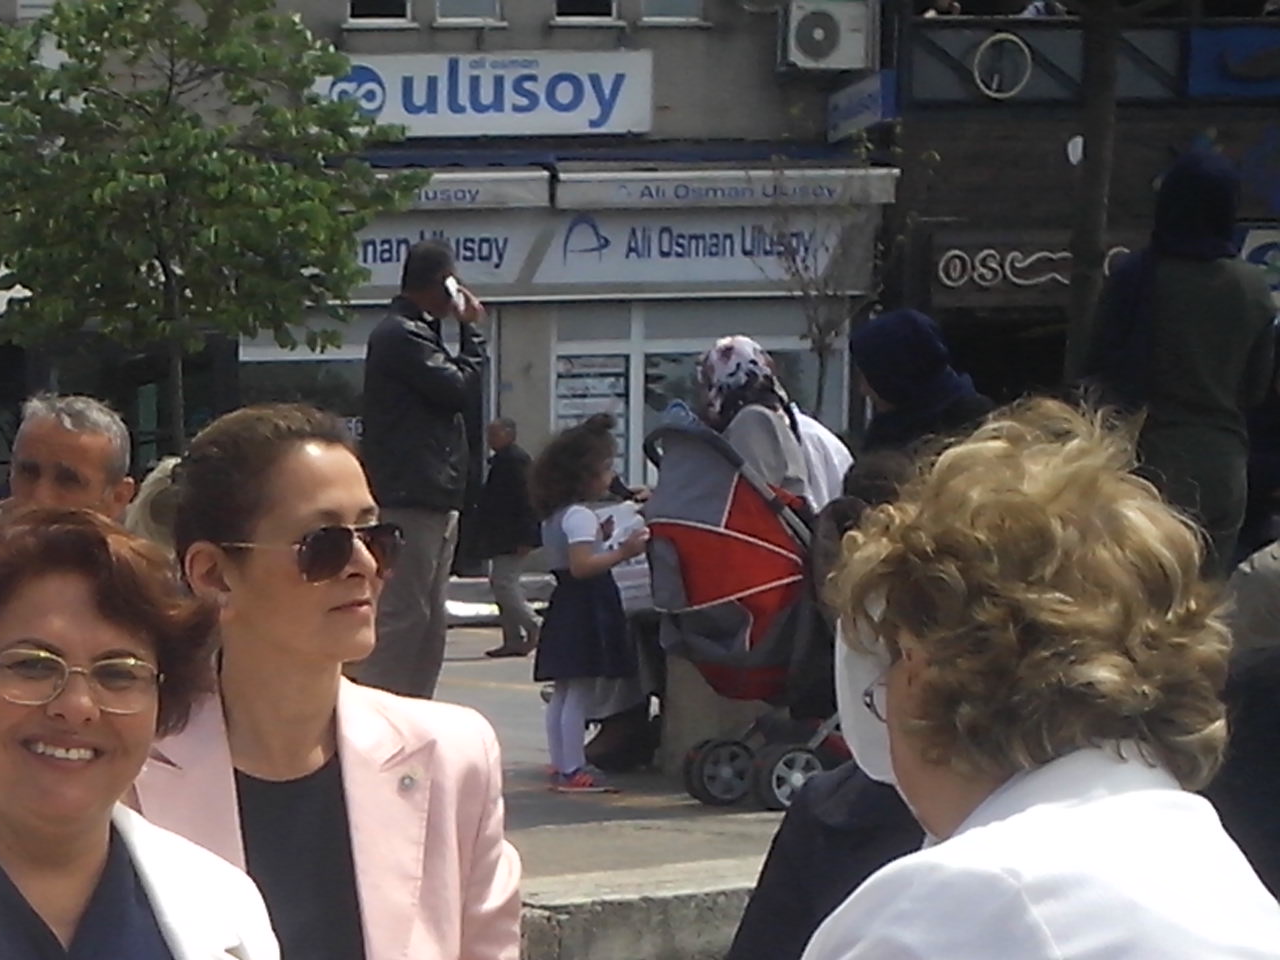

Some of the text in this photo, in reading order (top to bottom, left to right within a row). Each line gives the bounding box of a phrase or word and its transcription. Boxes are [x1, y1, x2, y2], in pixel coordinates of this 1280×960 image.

[401, 57, 626, 128] ulusoy
[640, 185, 666, 199] Ali
[673, 184, 754, 199] Osman
[625, 225, 651, 259] Ali
[658, 226, 735, 259] Osman
